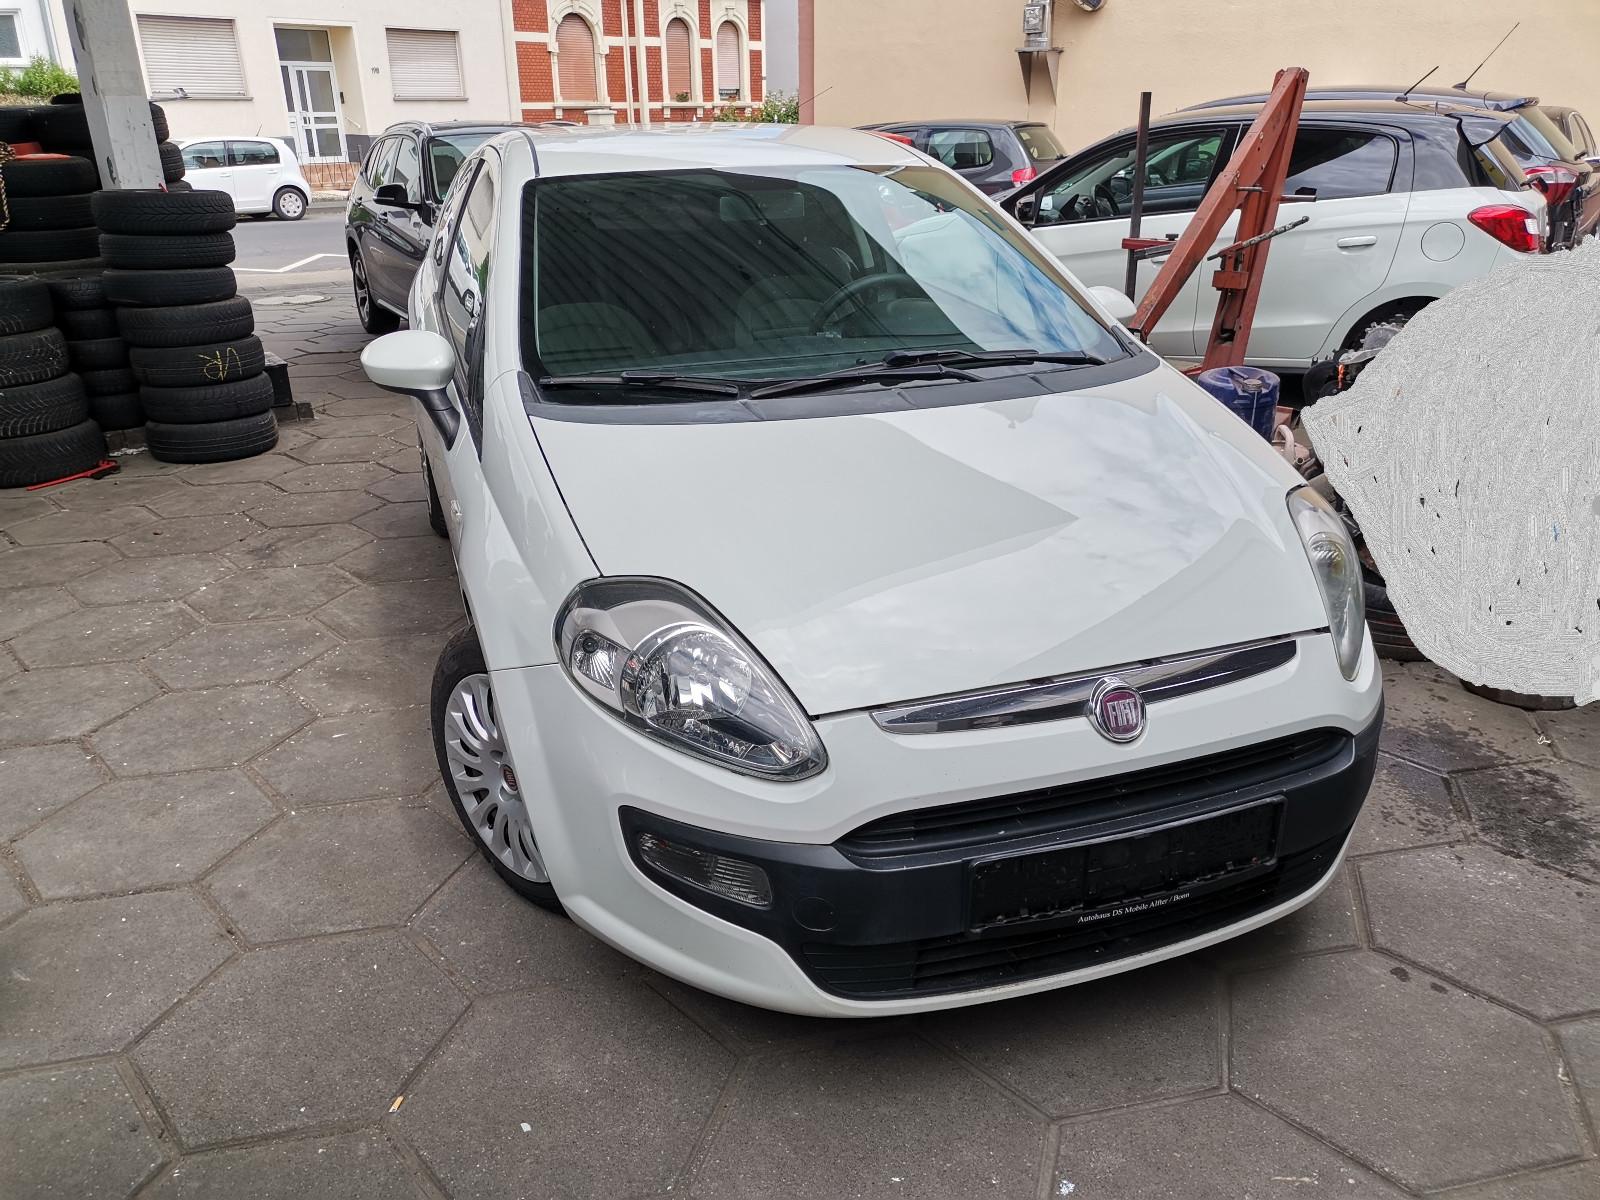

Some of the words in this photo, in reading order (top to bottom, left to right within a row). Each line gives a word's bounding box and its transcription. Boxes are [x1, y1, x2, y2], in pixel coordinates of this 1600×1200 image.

[1106, 698, 1137, 728] FIAT
[1078, 912, 1111, 923] Autohaus
[1112, 908, 1124, 917] DS
[1124, 902, 1149, 914] Mobile
[1173, 892, 1190, 902] Bonn
